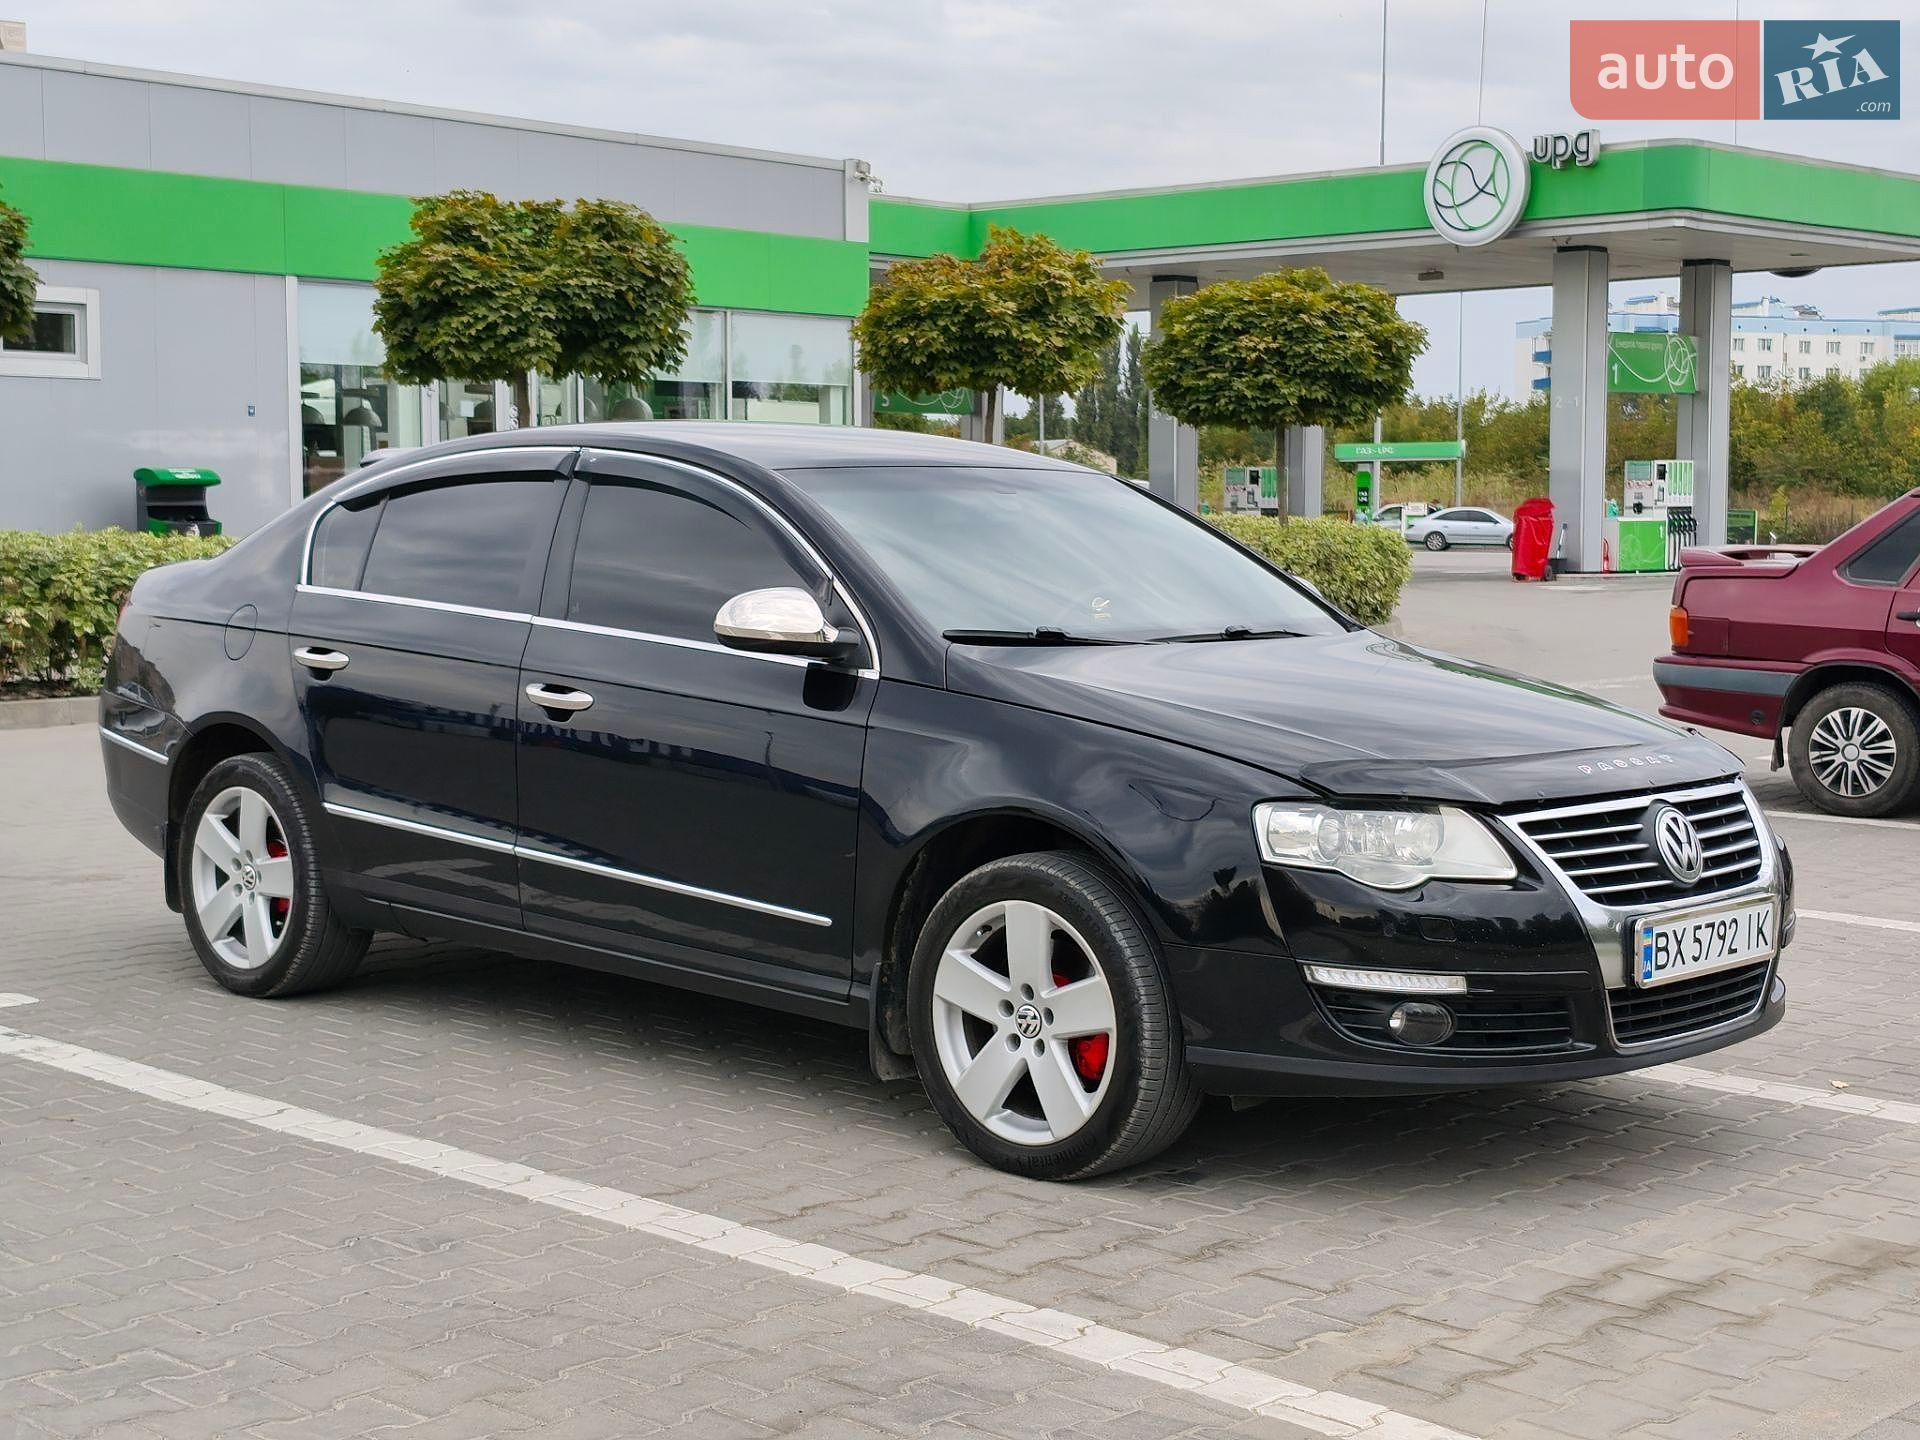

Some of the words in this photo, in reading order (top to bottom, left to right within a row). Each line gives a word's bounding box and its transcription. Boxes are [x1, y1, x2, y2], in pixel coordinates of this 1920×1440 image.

[1532, 129, 1600, 170] upg
[1655, 927, 1686, 970] BX
[1691, 917, 1738, 962] 5792
[1747, 909, 1769, 950] IK
